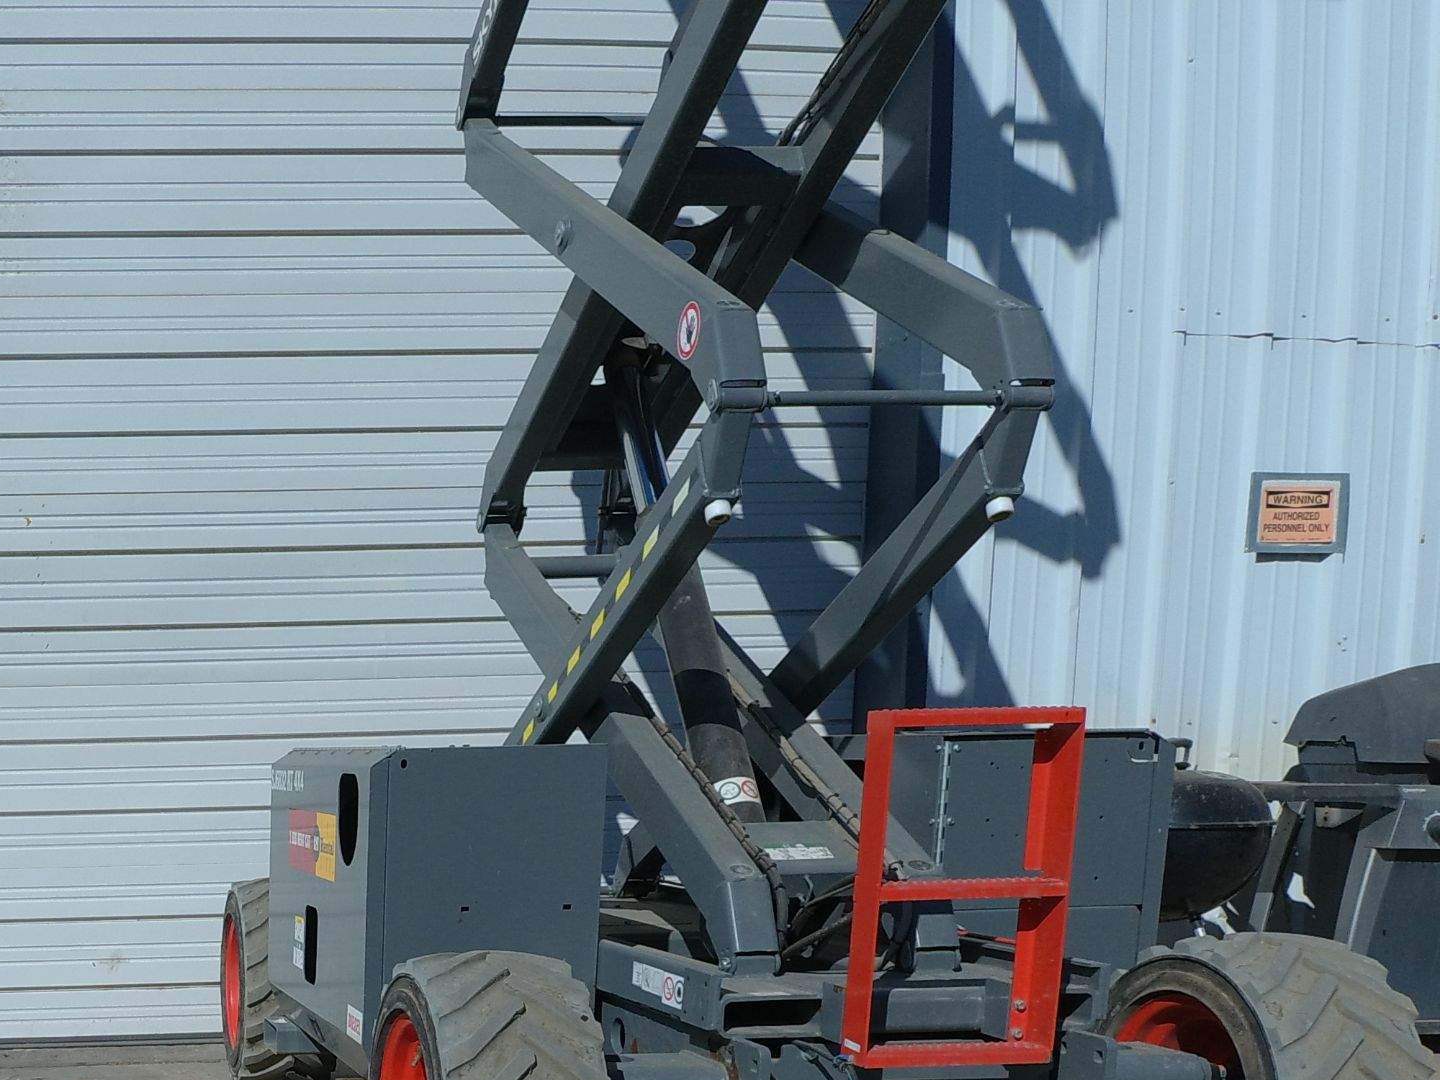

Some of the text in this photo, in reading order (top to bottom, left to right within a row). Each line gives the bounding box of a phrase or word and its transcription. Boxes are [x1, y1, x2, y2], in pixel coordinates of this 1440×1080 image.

[1273, 494, 1323, 505] WARNING
[1272, 511, 1320, 521] AUTHORIZED
[1263, 523, 1329, 533] PERSONNEL ONLY
